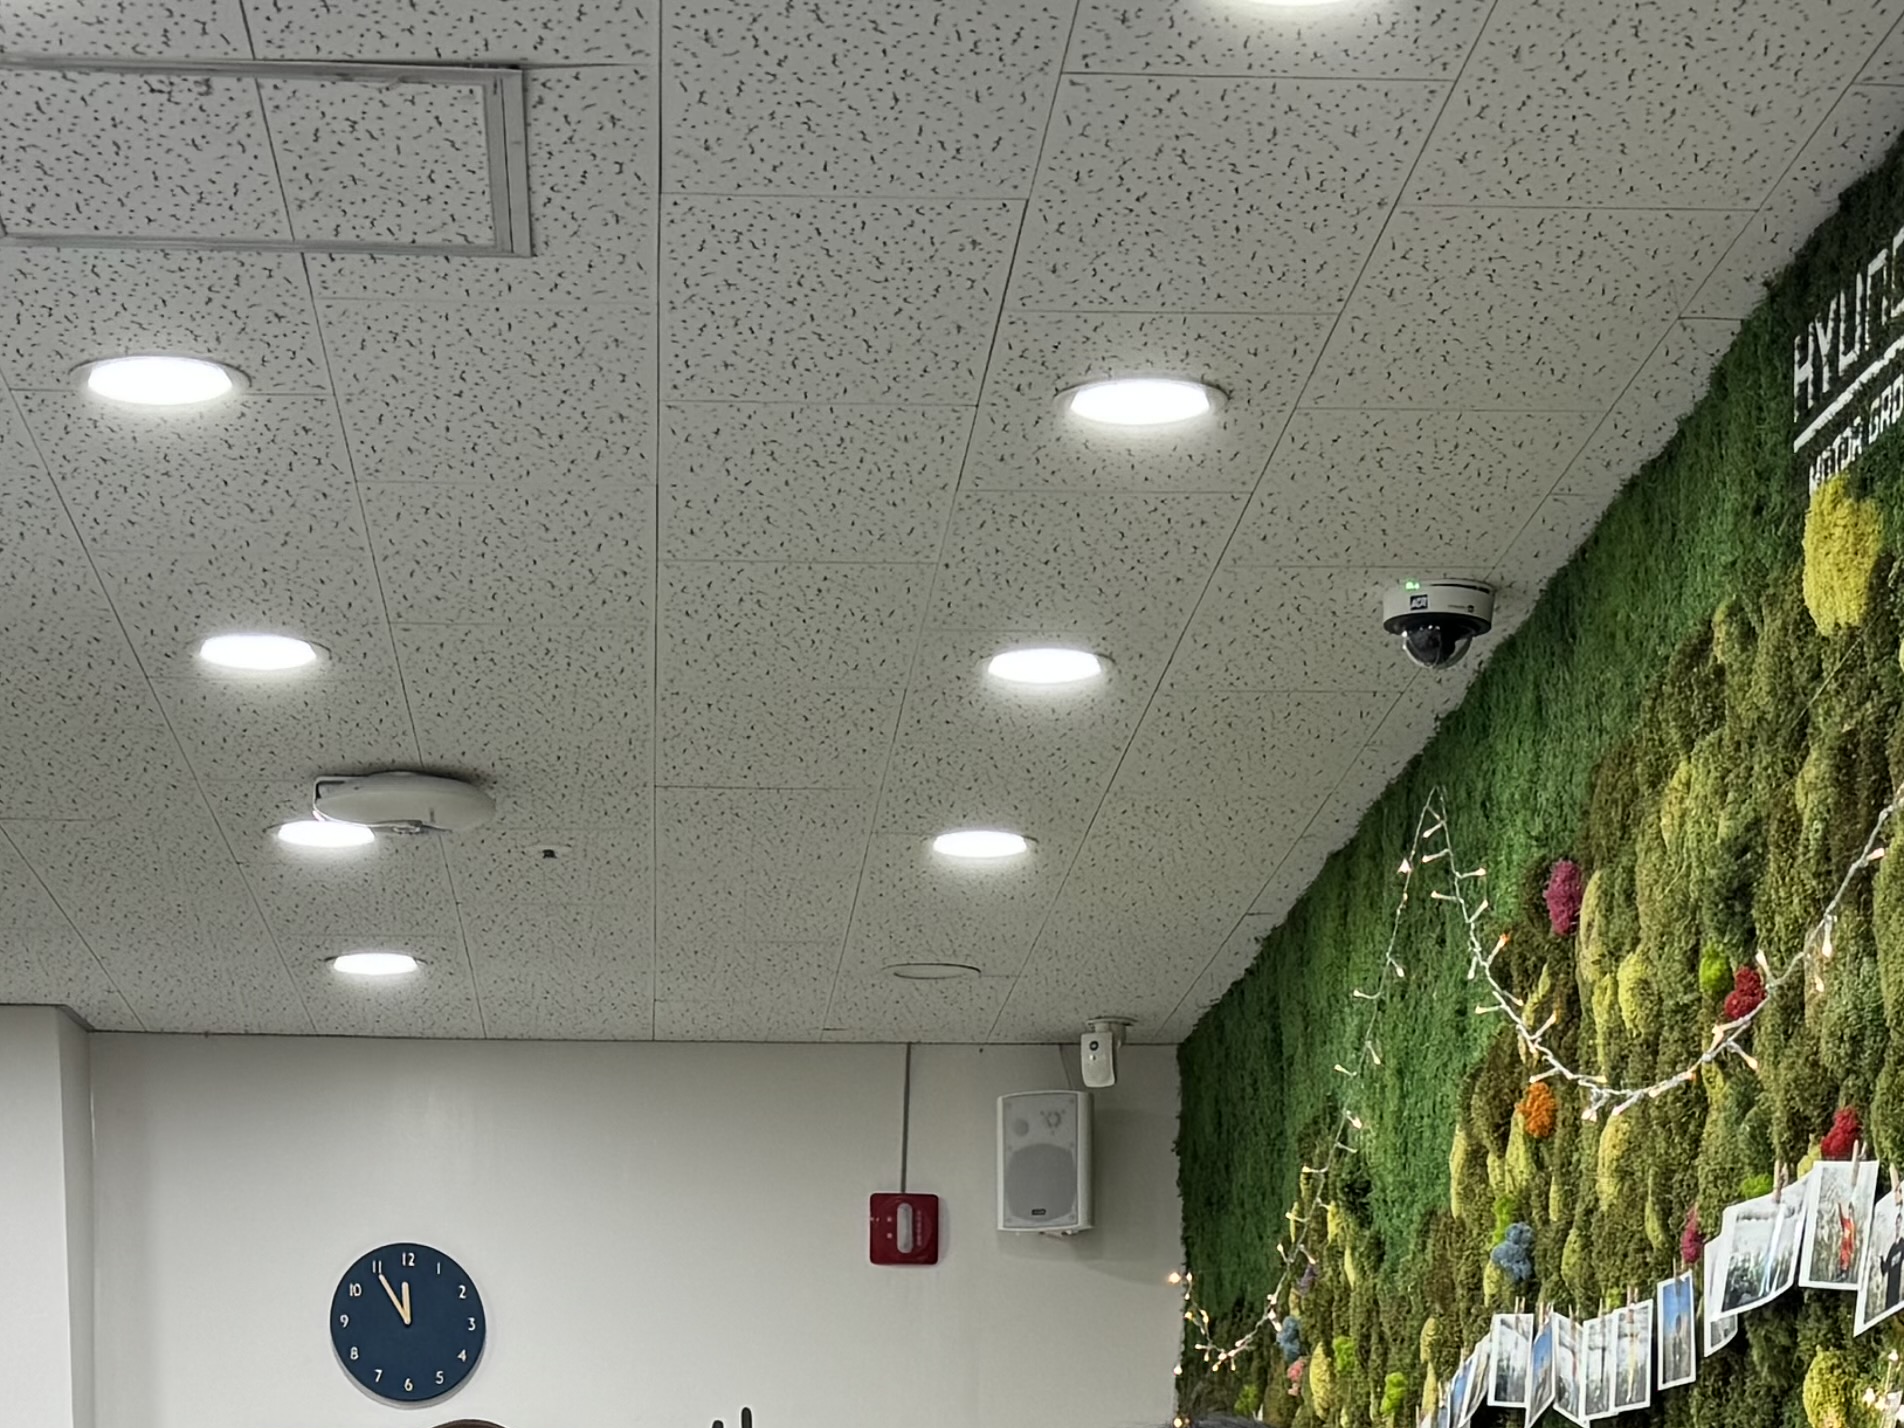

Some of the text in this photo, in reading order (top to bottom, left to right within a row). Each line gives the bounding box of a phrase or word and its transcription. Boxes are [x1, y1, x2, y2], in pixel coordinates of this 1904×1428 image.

[402, 1252, 415, 1266] 12
[372, 1260, 382, 1273] 11
[437, 1262, 441, 1275] 1
[349, 1283, 362, 1296] 10
[458, 1285, 467, 1299] 2
[340, 1314, 349, 1327] 9
[467, 1317, 476, 1331] 3
[350, 1347, 359, 1360] 8
[457, 1349, 467, 1362] 4
[374, 1369, 382, 1382] 7
[435, 1371, 444, 1384] 5
[404, 1378, 413, 1391] 6
